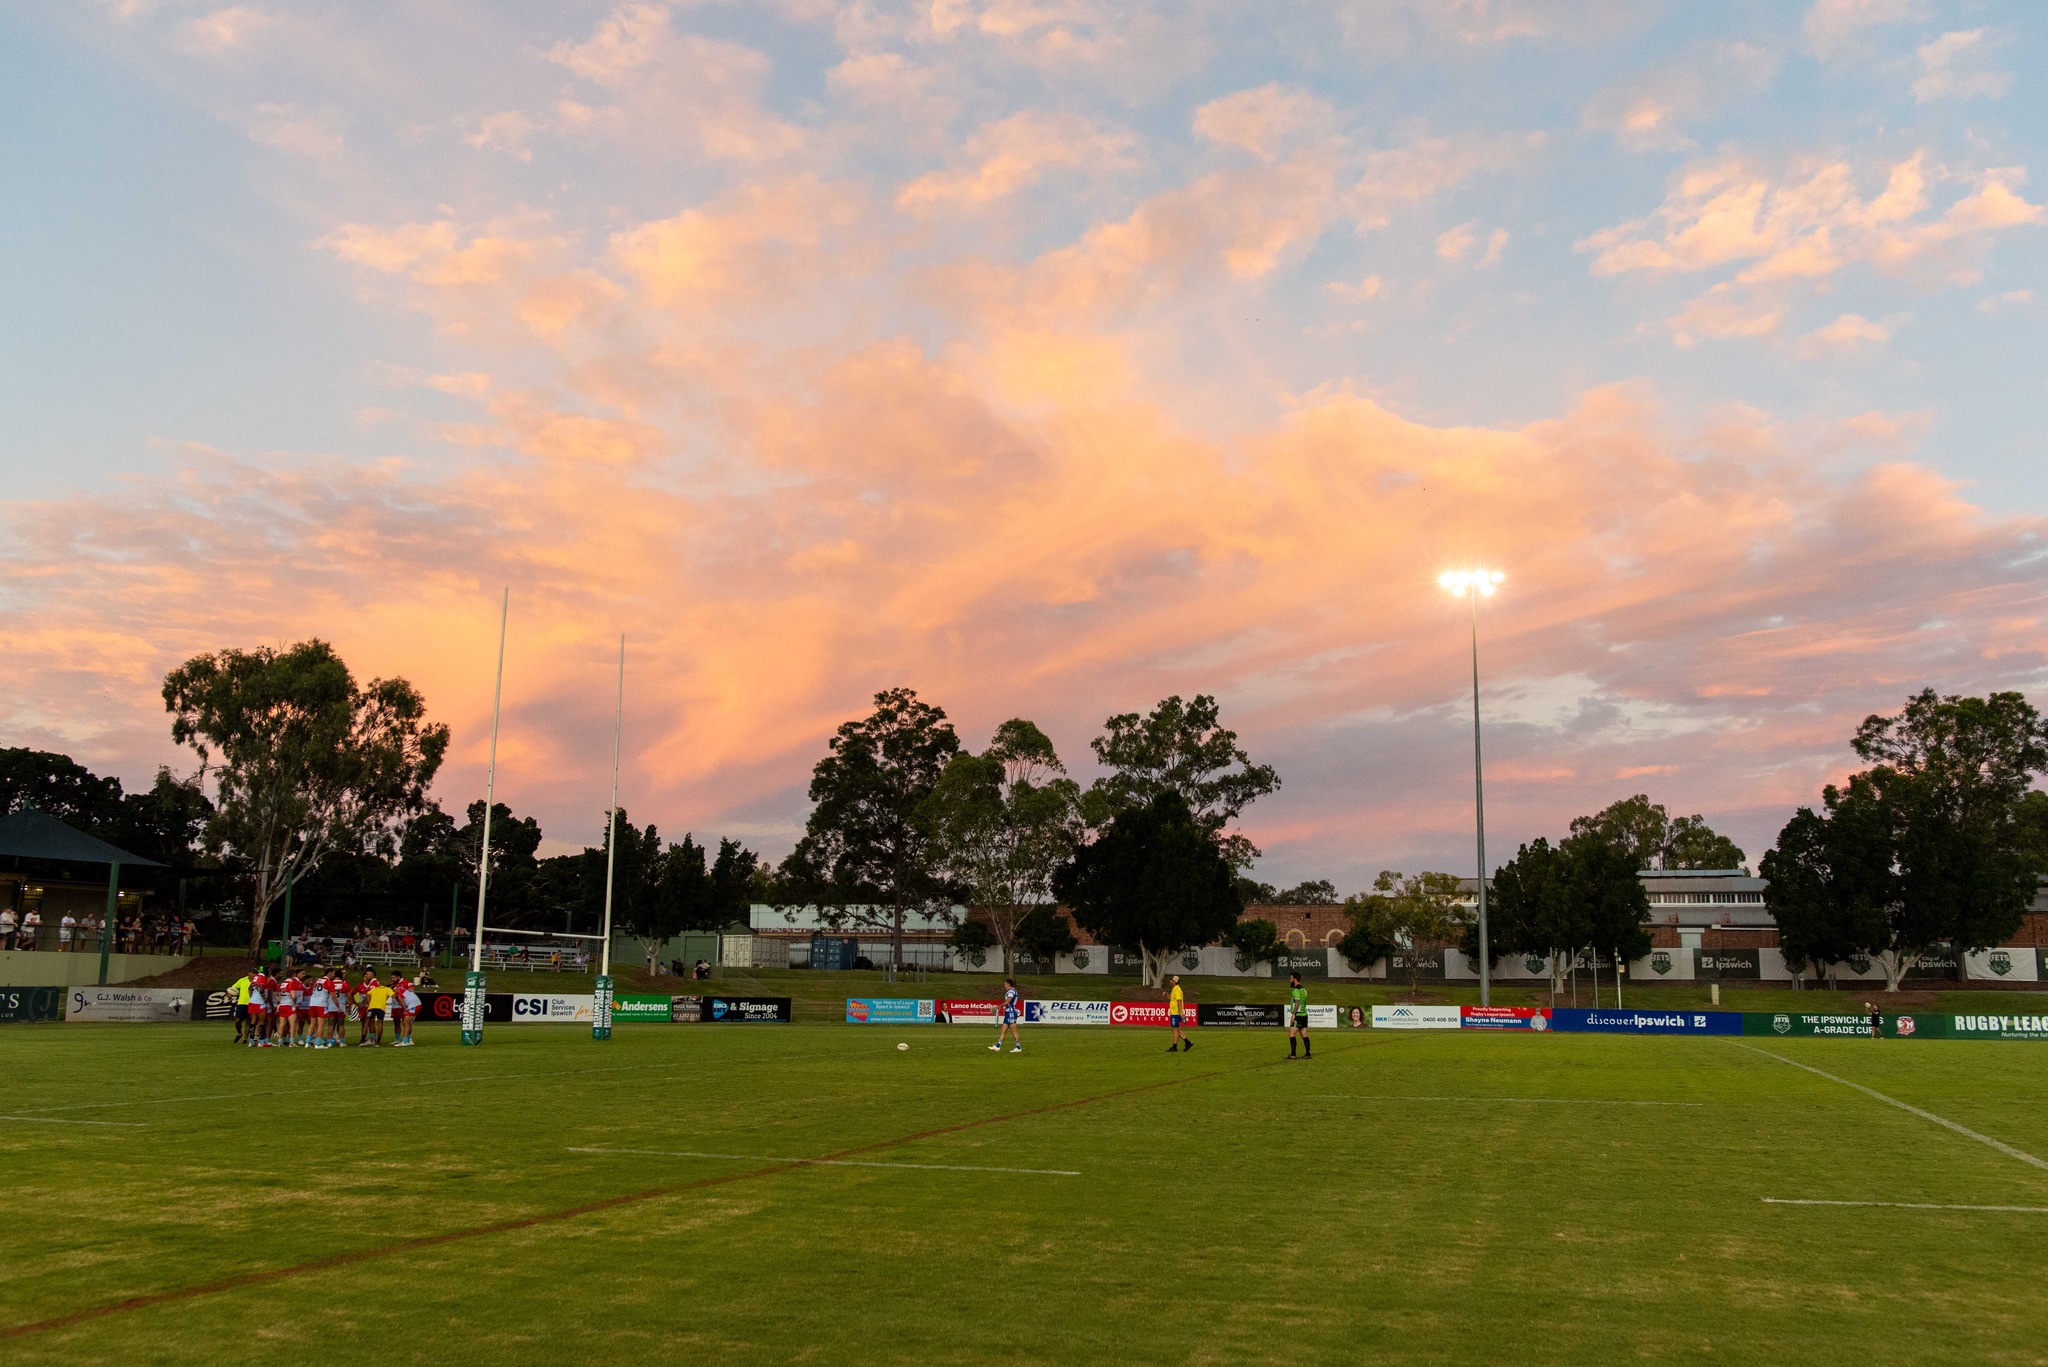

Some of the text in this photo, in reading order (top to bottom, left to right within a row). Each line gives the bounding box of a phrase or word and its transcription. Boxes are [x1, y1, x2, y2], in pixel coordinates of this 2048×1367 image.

[1290, 960, 1321, 969] Ipswich
[1716, 961, 1752, 970] Ipswich
[1918, 960, 1957, 970] Ipswich
[514, 998, 548, 1015] CSI
[621, 1001, 668, 1011] Andersens
[730, 1002, 778, 1012] & Signage
[1086, 1003, 1108, 1011] AIR
[1130, 1008, 1165, 1016] STRYBOS
[1954, 1016, 2008, 1030] RUGBY
